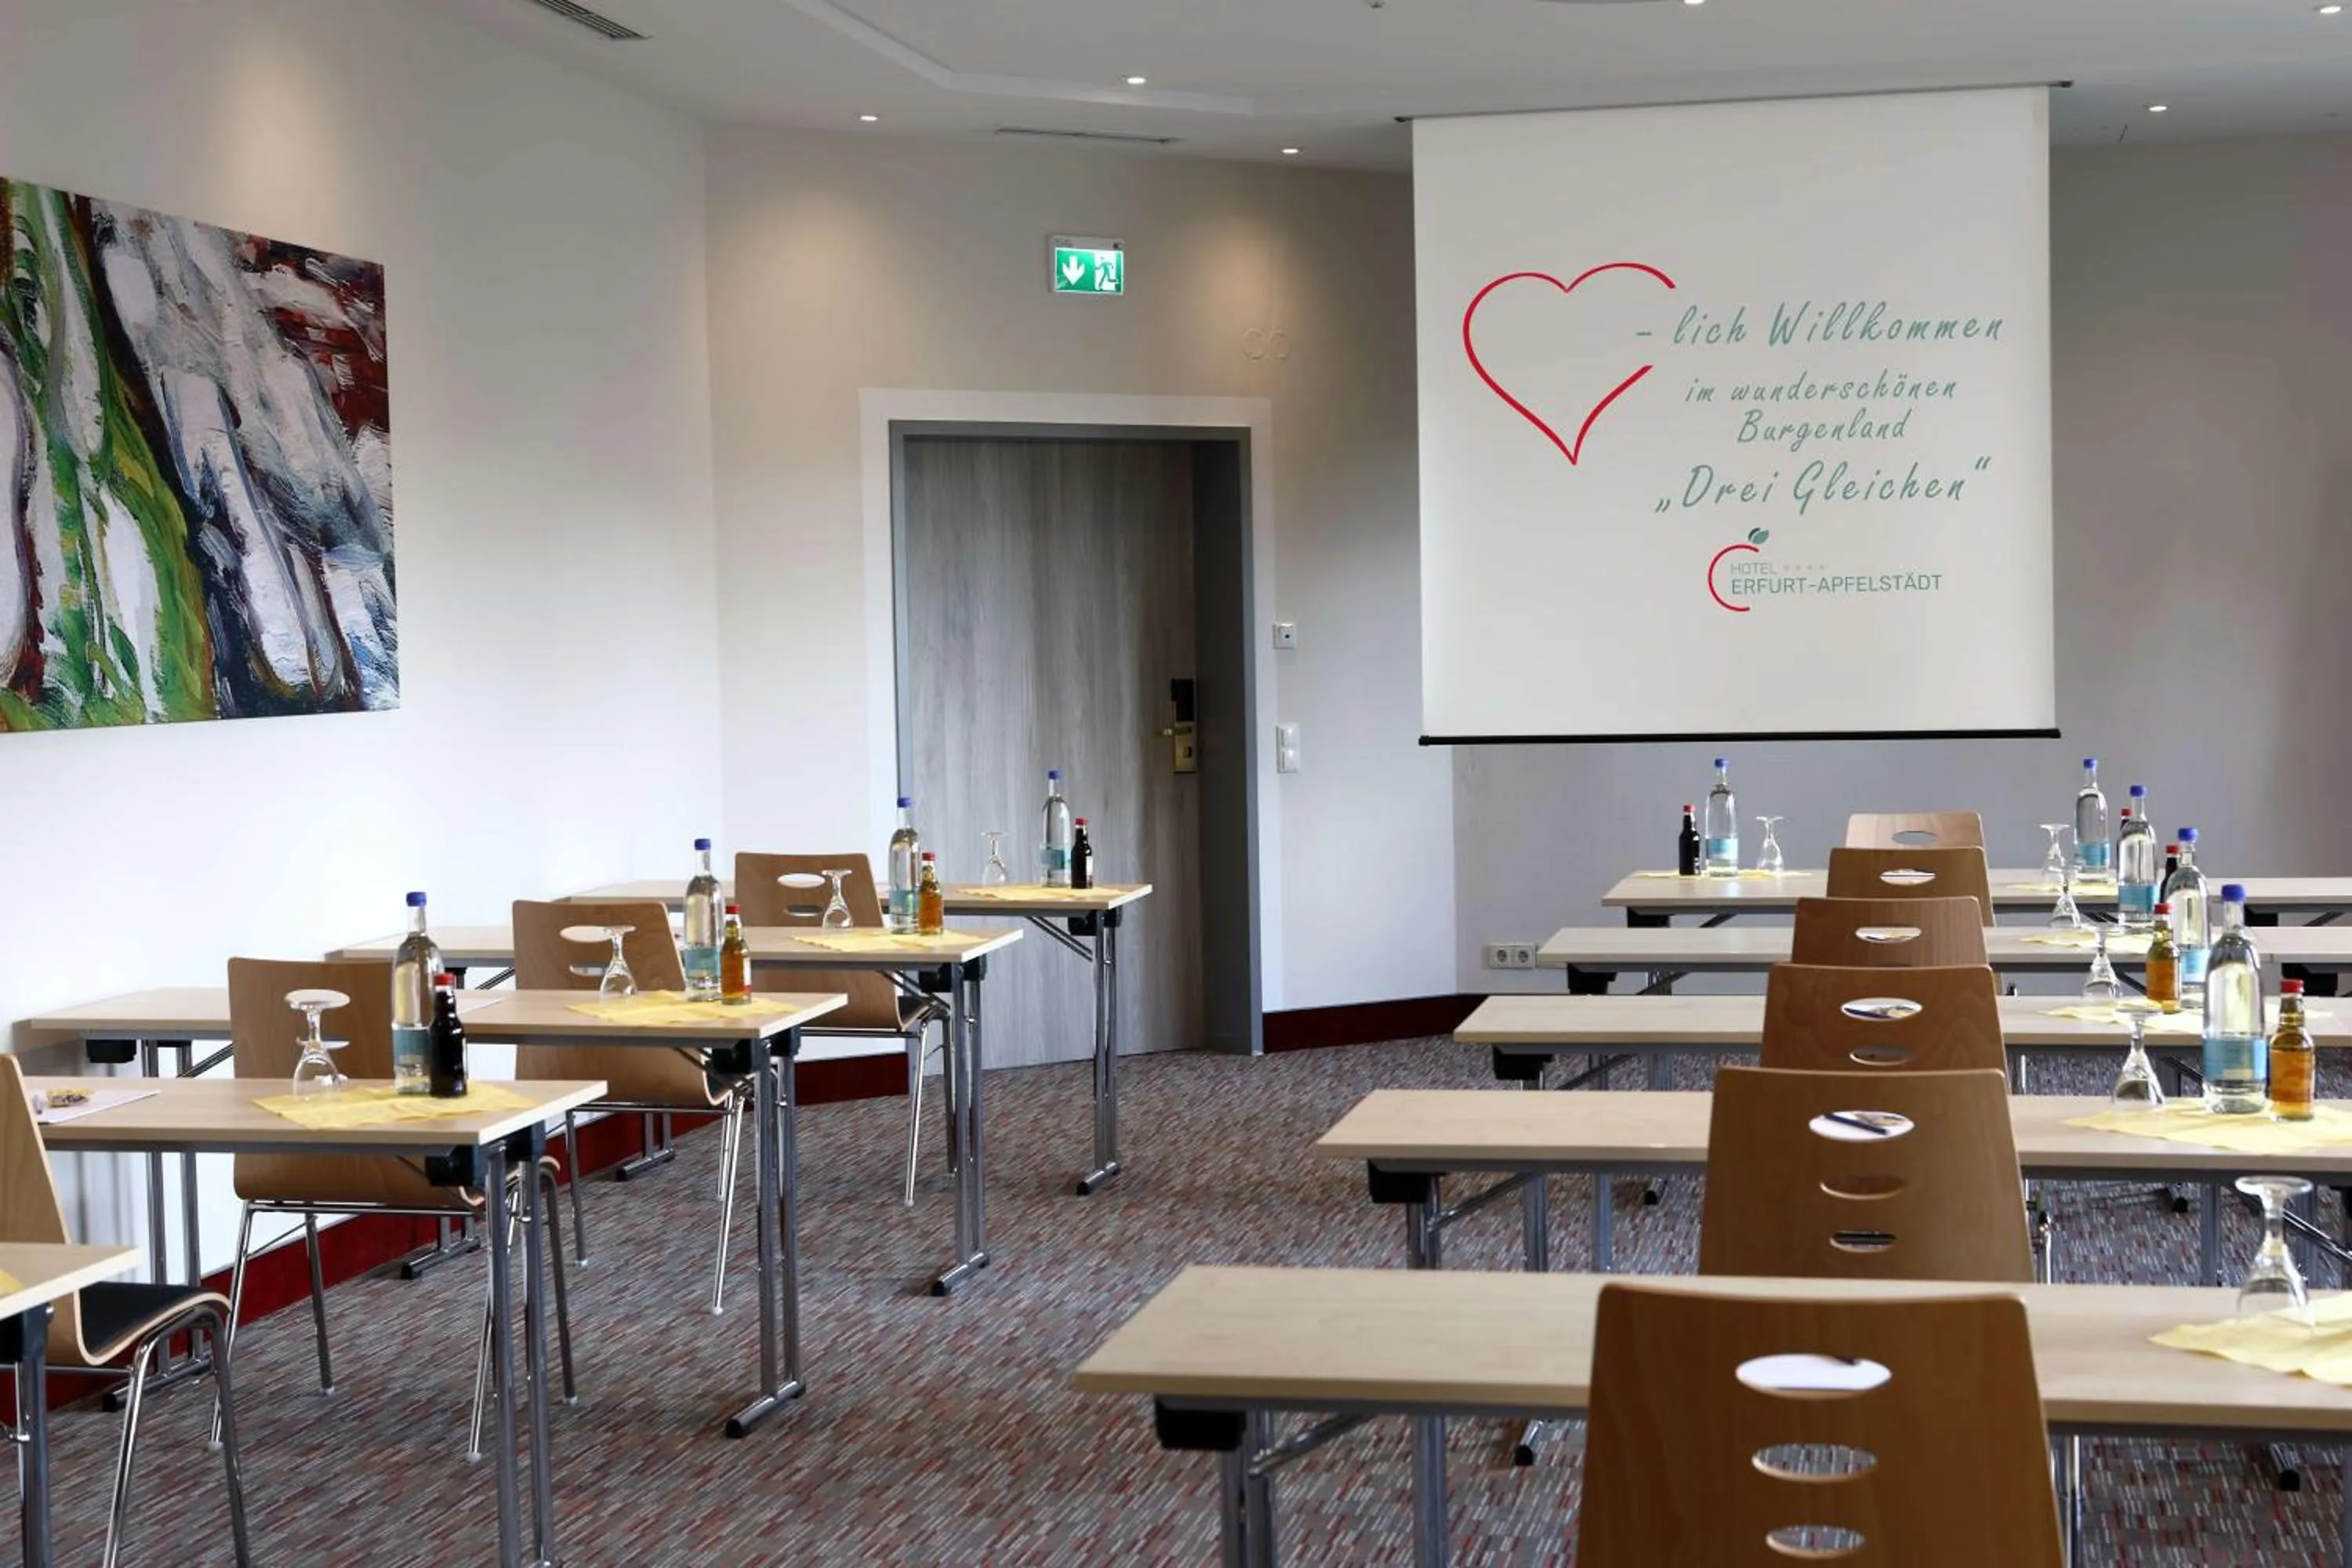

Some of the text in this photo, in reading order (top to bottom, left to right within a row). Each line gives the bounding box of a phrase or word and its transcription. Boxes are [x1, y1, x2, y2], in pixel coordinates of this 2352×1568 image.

[1673, 303, 1747, 345] lich
[1767, 300, 2004, 347] Willkommen
[1685, 368, 1957, 403] im wunderschönen
[1737, 407, 1913, 452] Burgenland
[1730, 561, 1778, 575] HOTEL
[1730, 572, 1944, 596] ERFURT-APFELSTÄDT
